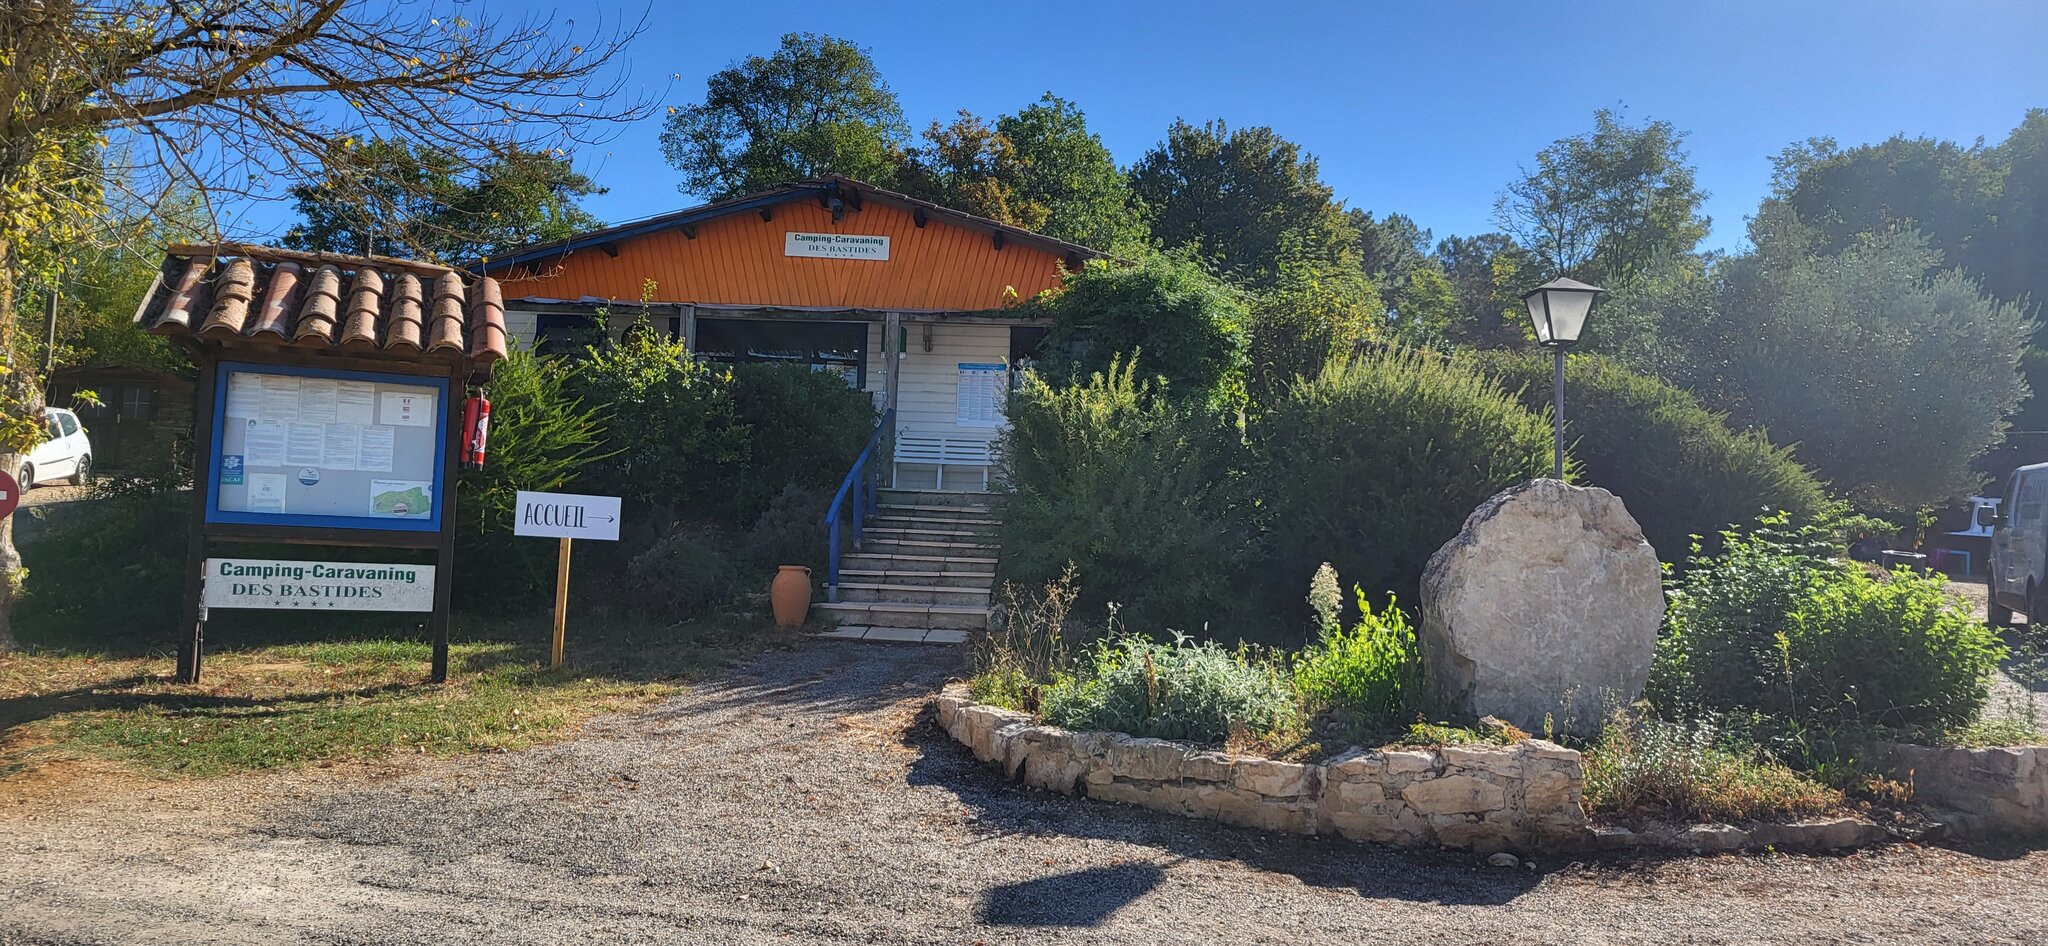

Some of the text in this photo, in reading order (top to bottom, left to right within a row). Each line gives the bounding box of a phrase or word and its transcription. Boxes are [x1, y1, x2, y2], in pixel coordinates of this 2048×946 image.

[794, 233, 884, 246] Camping-Caravaning
[808, 244, 877, 254] DES BASTIDES
[524, 502, 588, 528] ACCUEIL
[219, 561, 416, 583] Camping-Caravaning
[231, 583, 383, 598] DES BASTIDES
